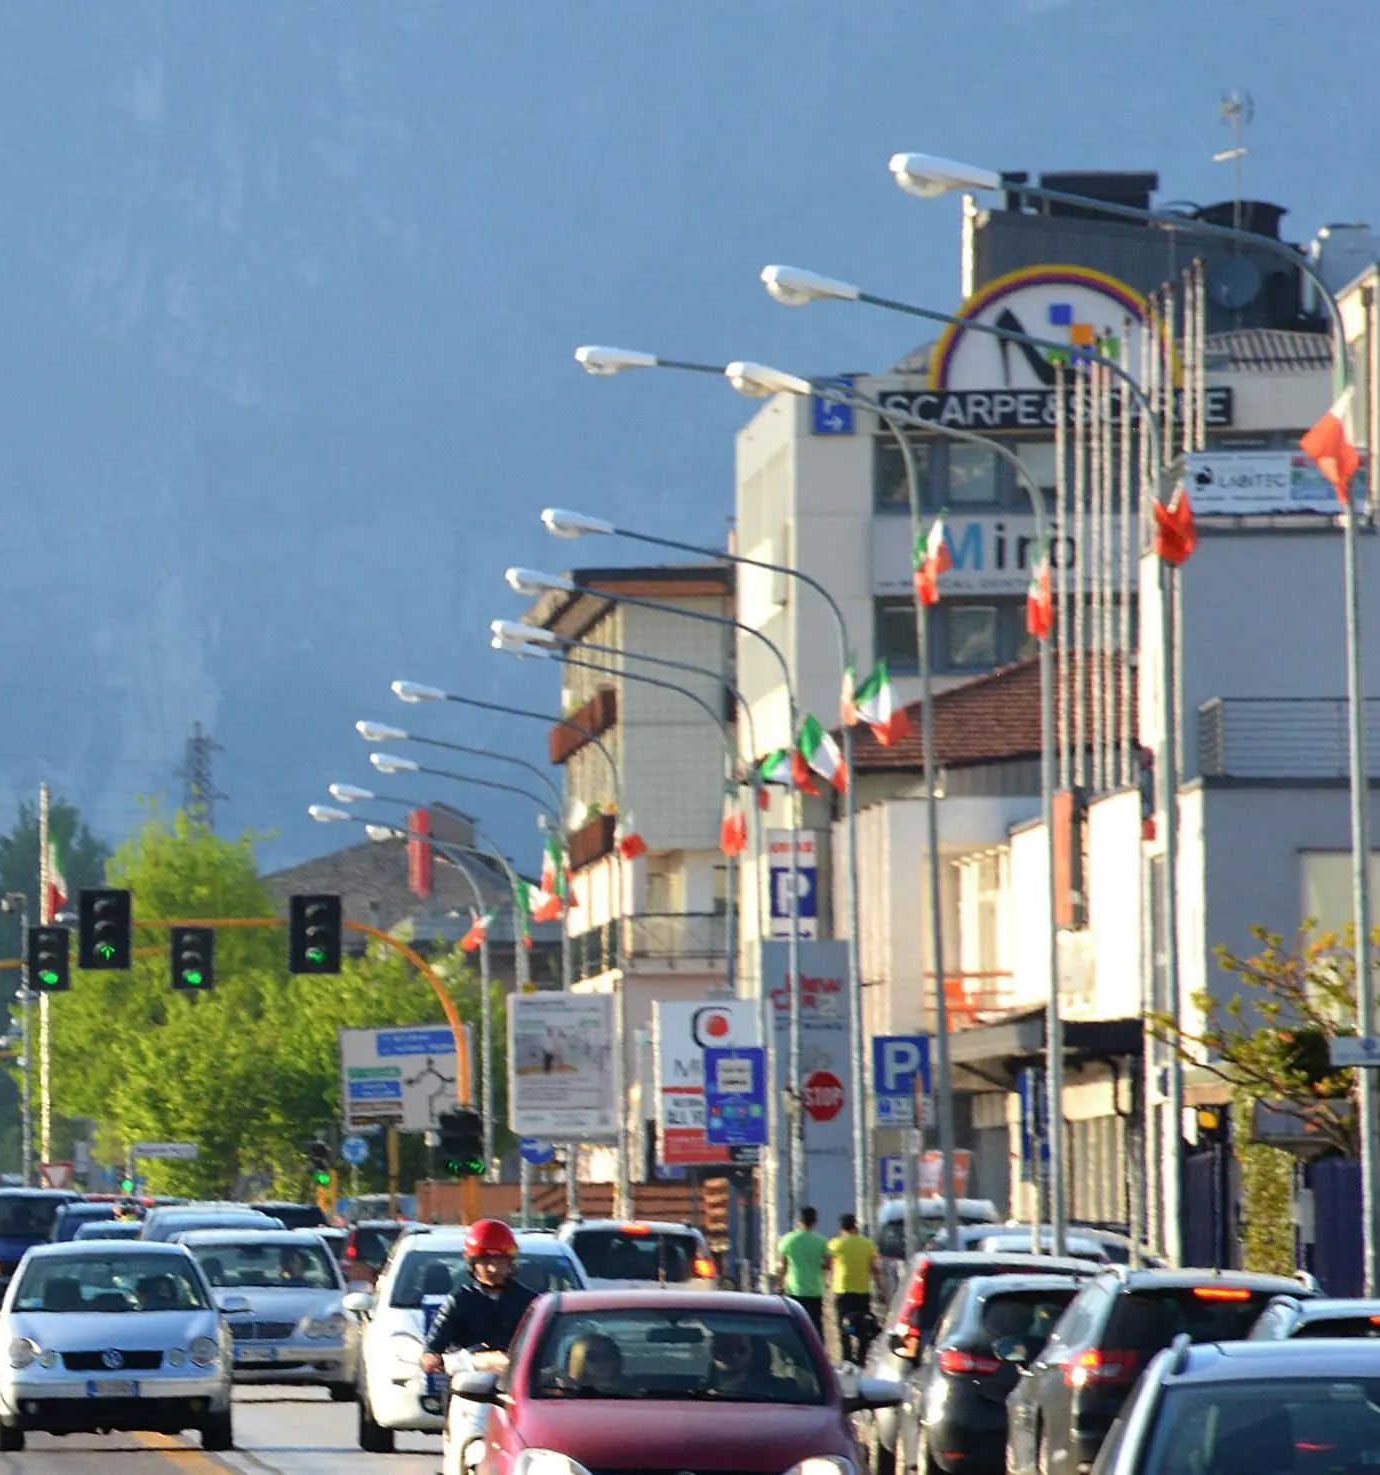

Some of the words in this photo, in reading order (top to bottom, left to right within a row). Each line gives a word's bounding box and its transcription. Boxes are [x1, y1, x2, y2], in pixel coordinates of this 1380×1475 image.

[776, 872, 810, 914] P
[883, 1042, 920, 1091] P
[804, 1086, 841, 1106] STOP
